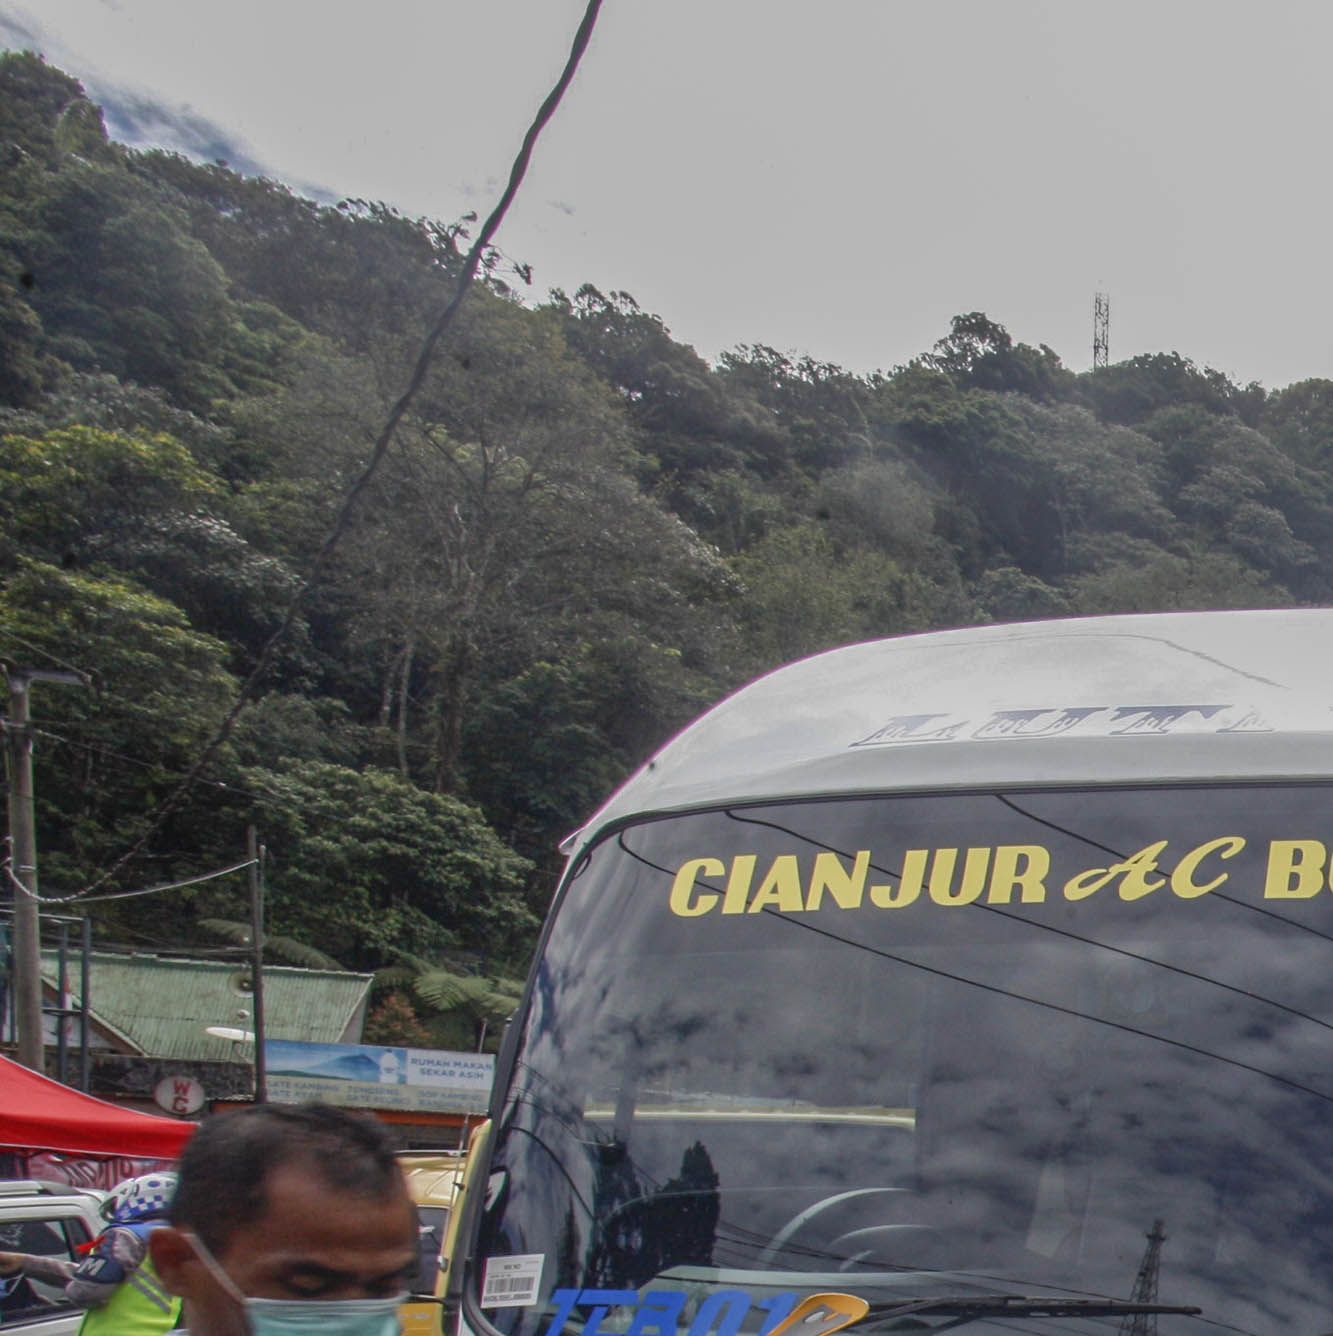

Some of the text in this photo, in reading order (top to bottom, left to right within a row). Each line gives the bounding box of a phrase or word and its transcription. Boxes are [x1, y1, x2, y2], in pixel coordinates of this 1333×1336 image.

[669, 844, 1051, 917] CIANJUR
[1063, 836, 1246, 901] AC
[410, 1057, 493, 1070] RUMAH MAKAN
[419, 1067, 485, 1080] SEKAR ASIH
